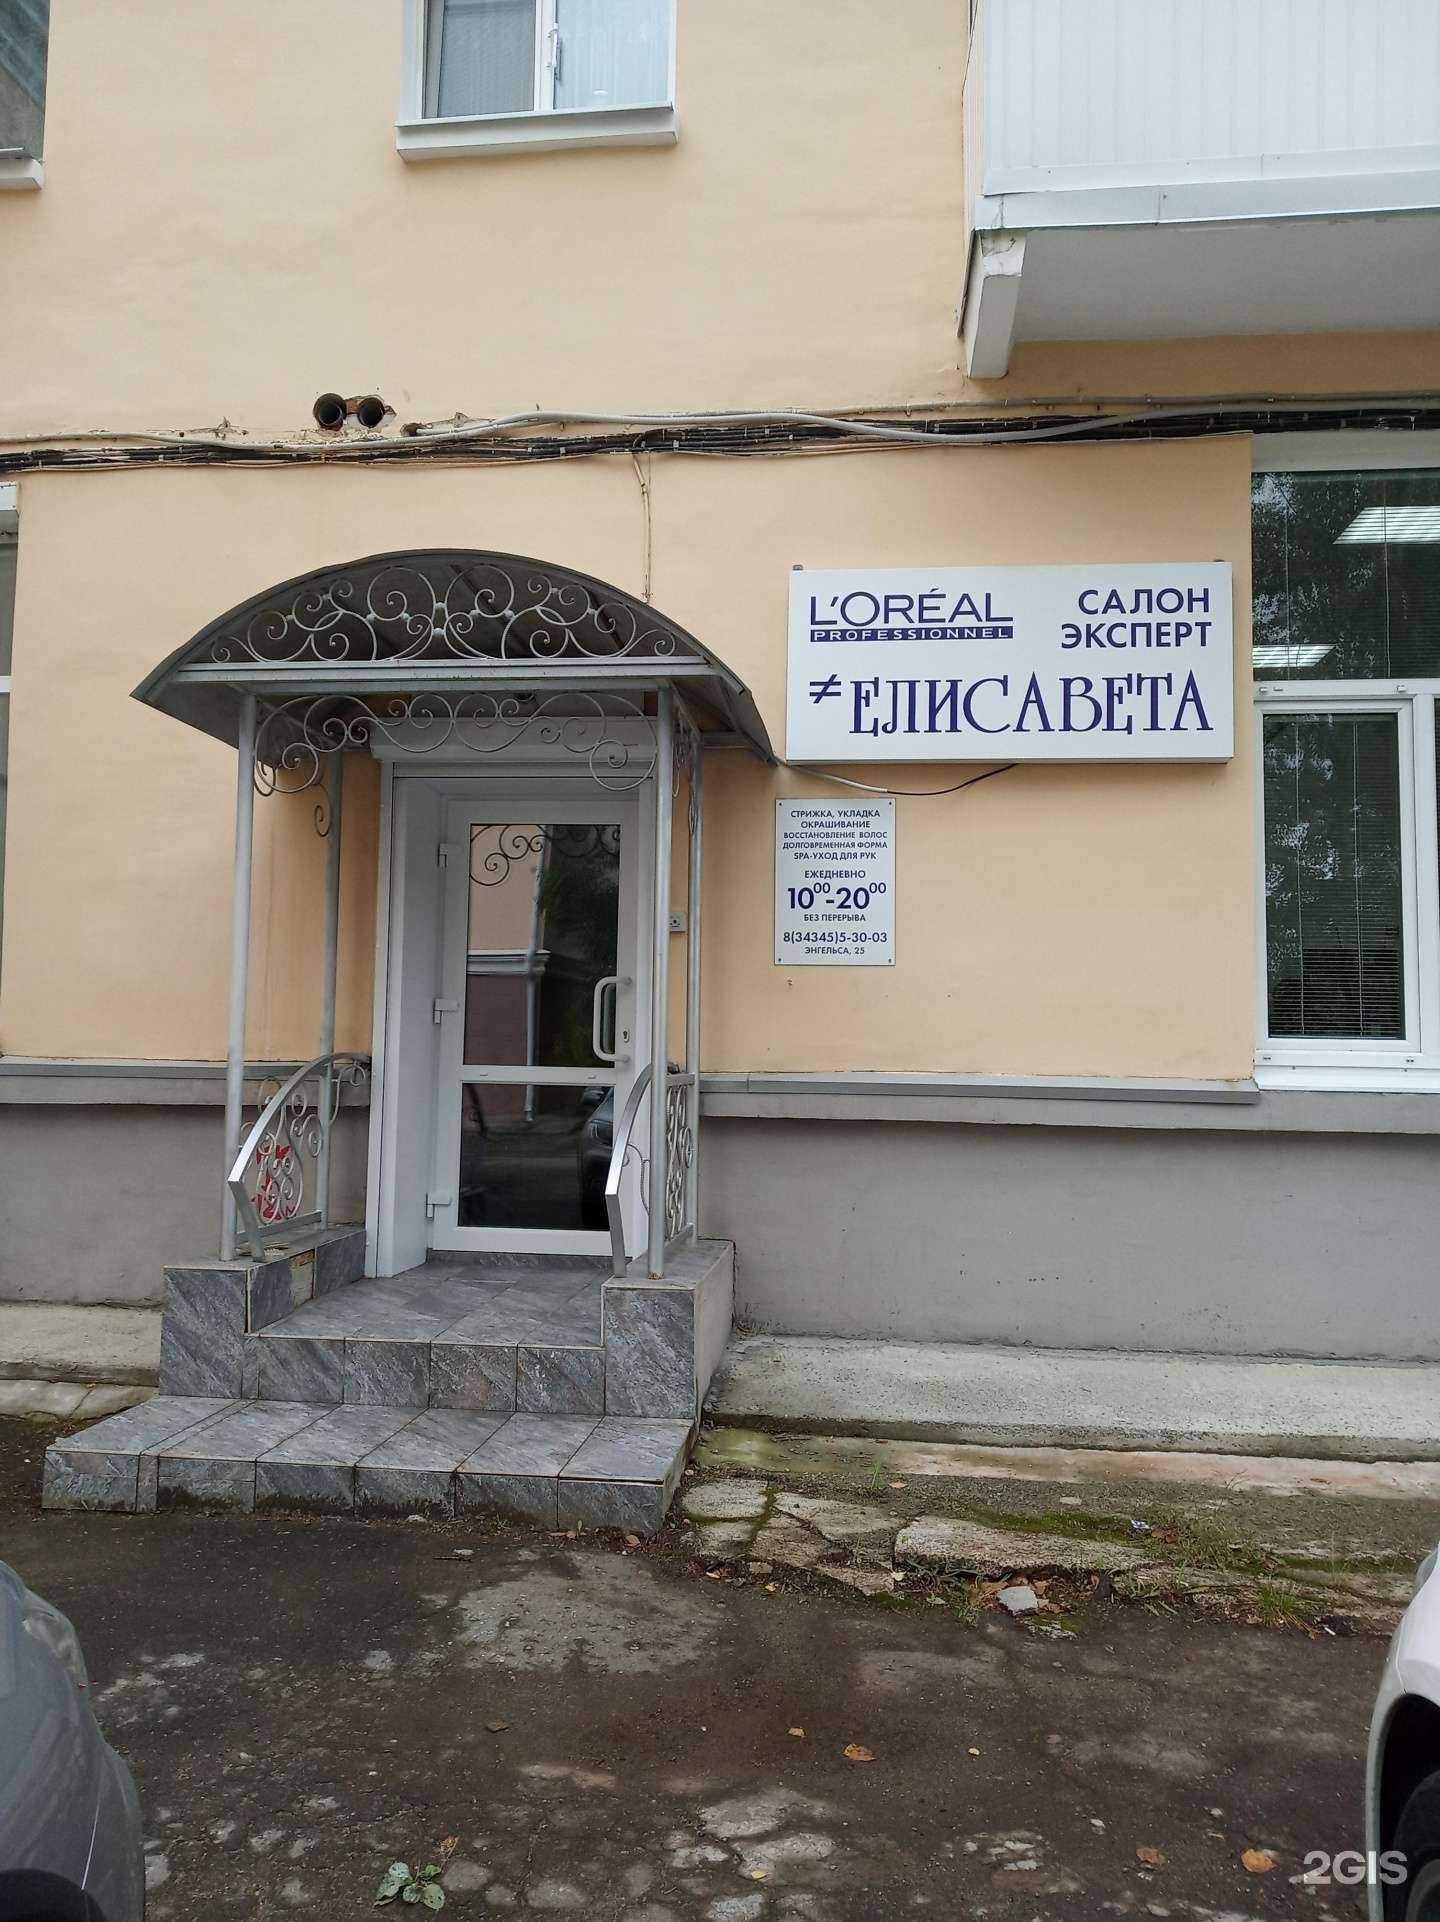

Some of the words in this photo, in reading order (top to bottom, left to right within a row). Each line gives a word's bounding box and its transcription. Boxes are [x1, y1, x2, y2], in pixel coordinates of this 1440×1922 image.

[1078, 588, 1209, 615] САЛОН
[810, 587, 1014, 627] L'ORÉAL
[813, 627, 1010, 641] PROFESSIONNEL
[1061, 621, 1212, 648] ЭКСПЕРТ
[849, 669, 1214, 737] ЕЛИСАВЕТА
[790, 810, 835, 818] СТРИЖКА,
[837, 809, 880, 818] УКЛАДКА
[800, 820, 871, 829] ОКРАШИВАНИЕ
[783, 831, 856, 839] ВОССТАНОВЛЕНИЕ
[859, 831, 888, 839] ВОЛОС
[782, 841, 856, 850] ДОЛГОВРЕМЕННАЯ
[857, 841, 888, 849] ФОРМА
[793, 852, 838, 860] SPA-УХОД
[839, 852, 858, 860] ДЛЯ
[859, 852, 877, 860] РУК
[804, 870, 866, 880] ЕЖЕДНЕВНО
[803, 914, 820, 922] БЕЗ
[821, 914, 866, 922] ПЕРЕРЫВА
[783, 931, 888, 944] 8(34345)5-30-03
[804, 947, 852, 955] ЭНГЕЛЬСА,
[854, 947, 865, 955] 25
